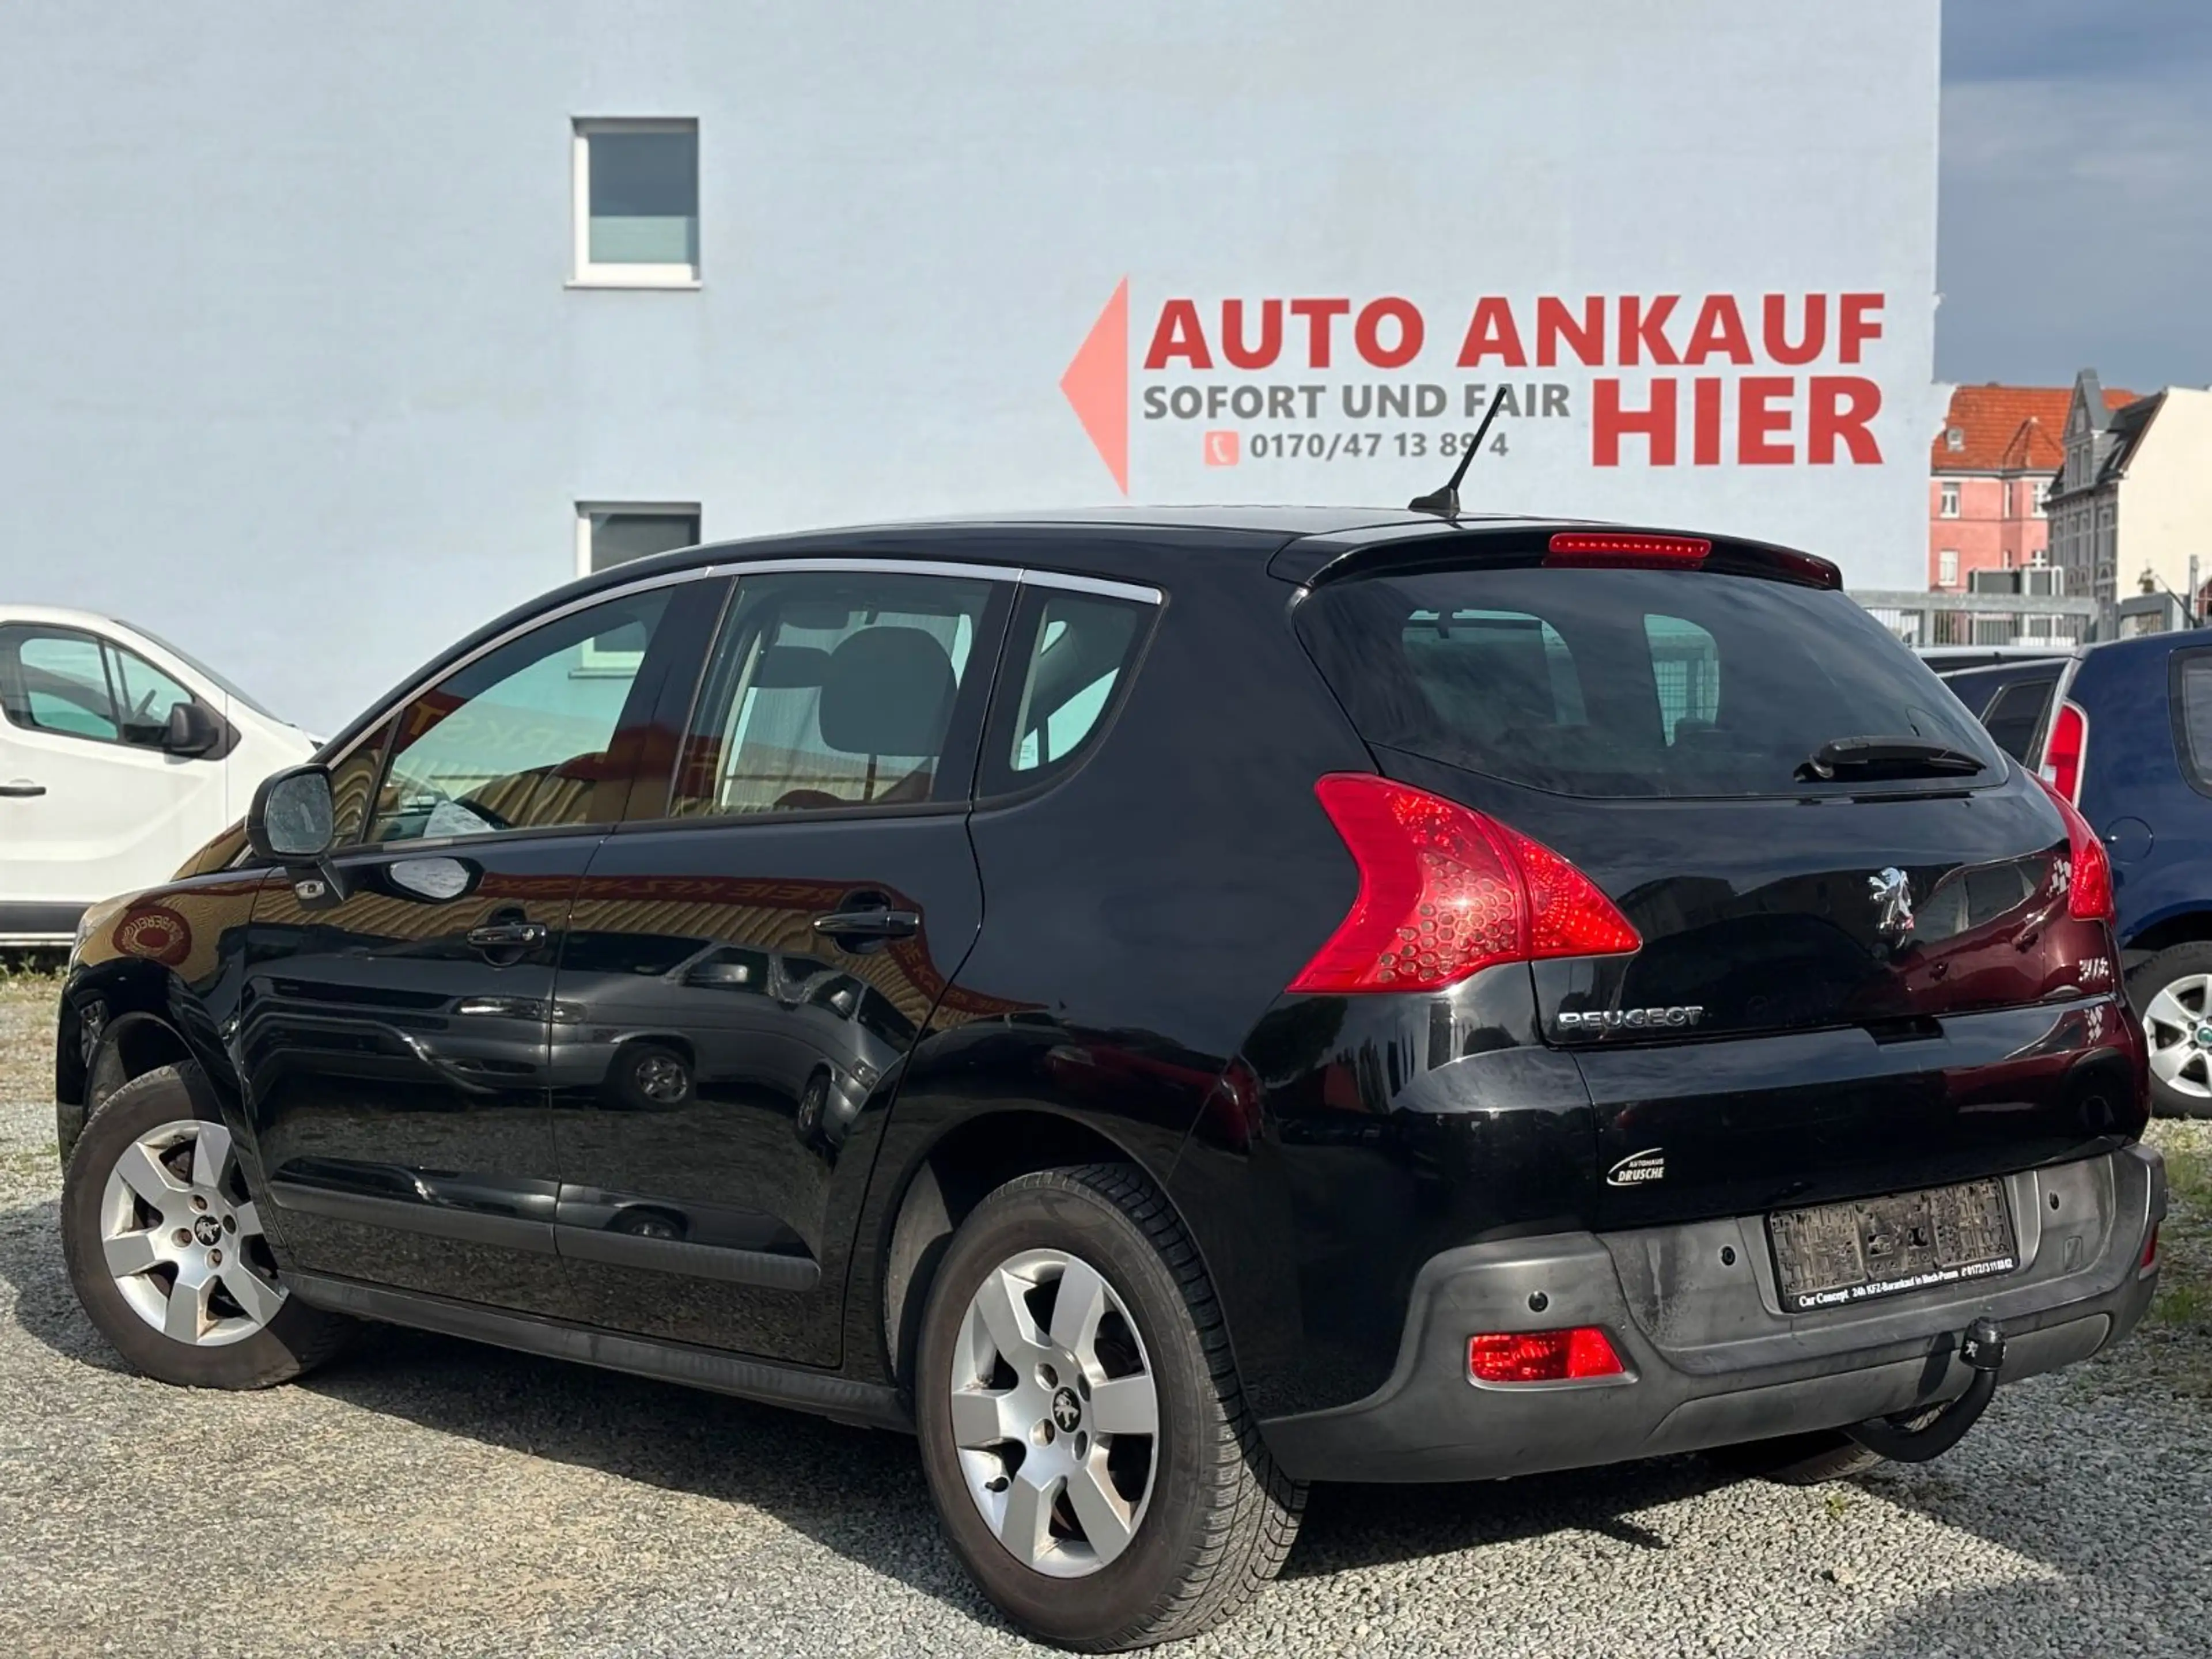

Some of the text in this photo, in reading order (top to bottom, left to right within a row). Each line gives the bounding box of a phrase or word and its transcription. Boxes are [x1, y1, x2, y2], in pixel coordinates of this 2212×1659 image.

[1144, 293, 1884, 370] AUTO ANKAUF
[1143, 383, 1570, 419] SOFORT UND FAIR
[1592, 376, 1883, 467] HIER
[1250, 433, 1382, 462] 0170/47
[1393, 432, 1427, 457] 13
[1556, 1006, 1703, 1031] PEUGEOT
[1618, 1166, 1665, 1182] DRUSCHE
[1798, 1295, 1815, 1308] Car
[1816, 1289, 1850, 1304] Concept
